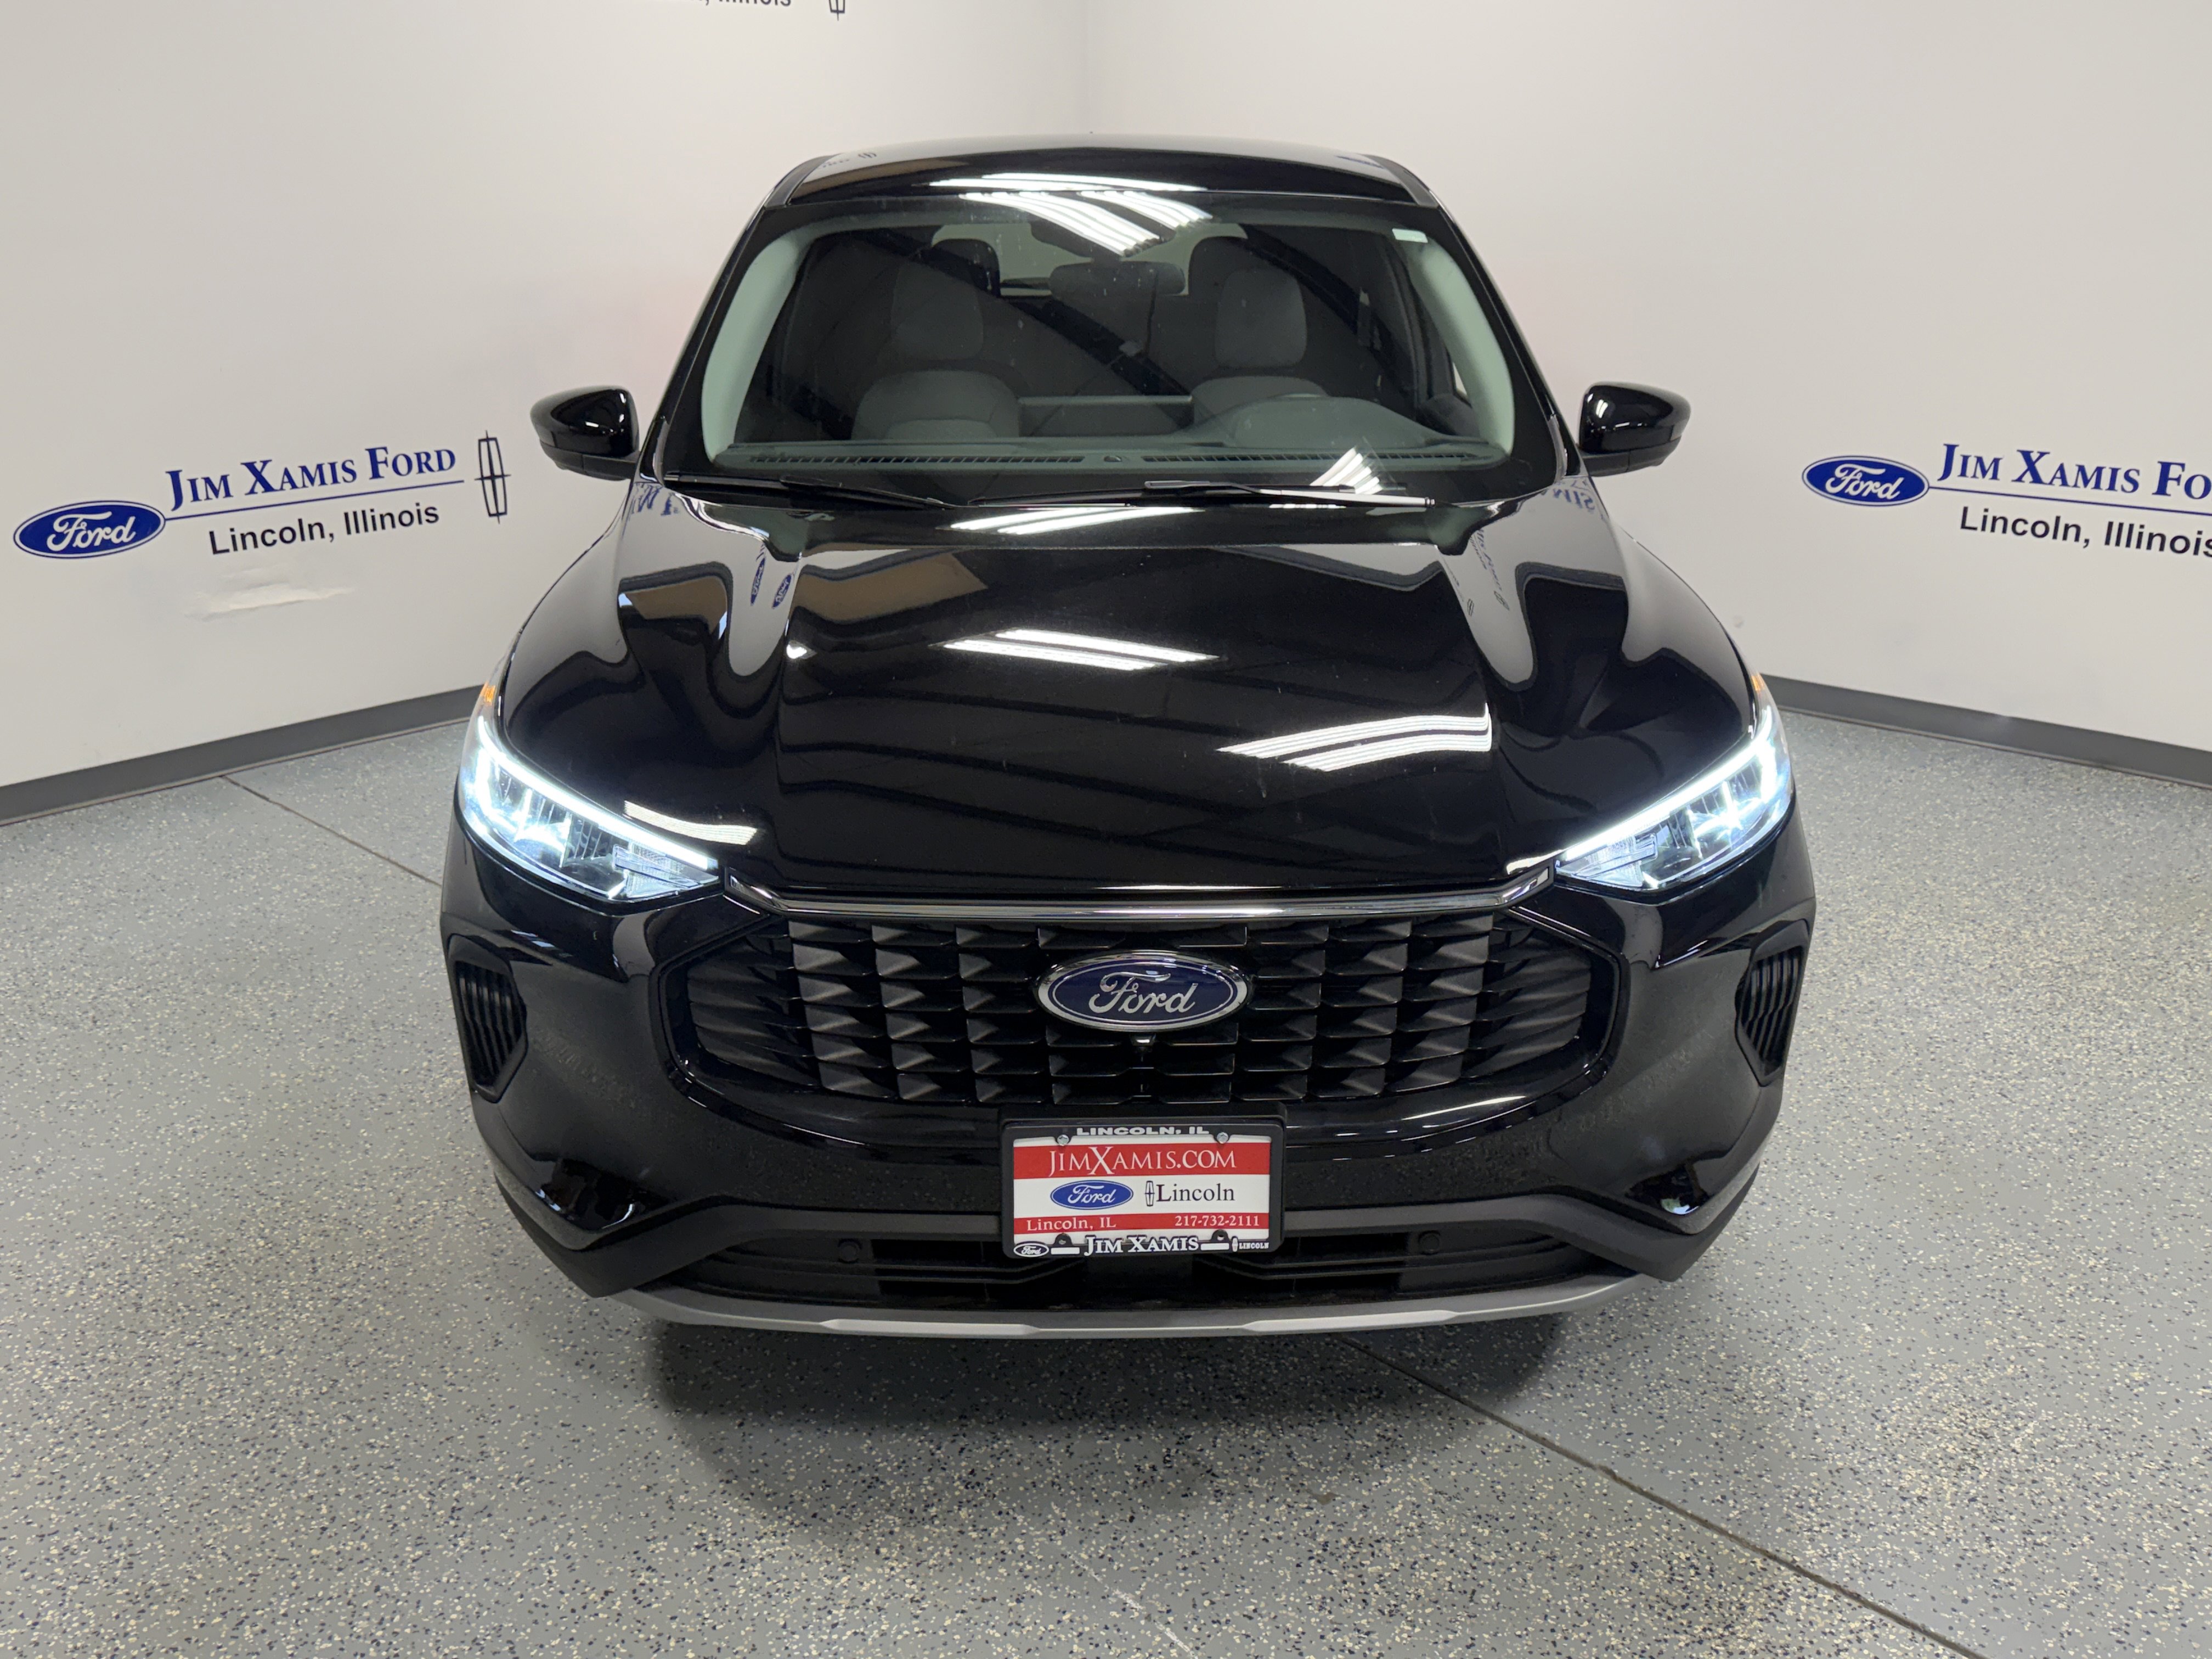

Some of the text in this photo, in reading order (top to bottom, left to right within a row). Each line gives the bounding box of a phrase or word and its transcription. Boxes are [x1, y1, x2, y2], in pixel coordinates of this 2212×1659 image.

[1825, 463, 1905, 500] Ford
[2152, 461, 2212, 500] FO
[47, 511, 137, 551] Ford
[209, 503, 439, 555] Lincoln, Illinois
[1960, 506, 2090, 549] Lincoln,
[1088, 971, 1198, 1014] Ford
[1076, 1126, 1210, 1136] LINCOLN, IL
[1067, 1184, 1117, 1204] Ford
[1155, 1183, 1235, 1203] Lincoln
[1026, 1216, 1117, 1231] Lincoln, IL
[1175, 1215, 1260, 1227] 217-732-2111
